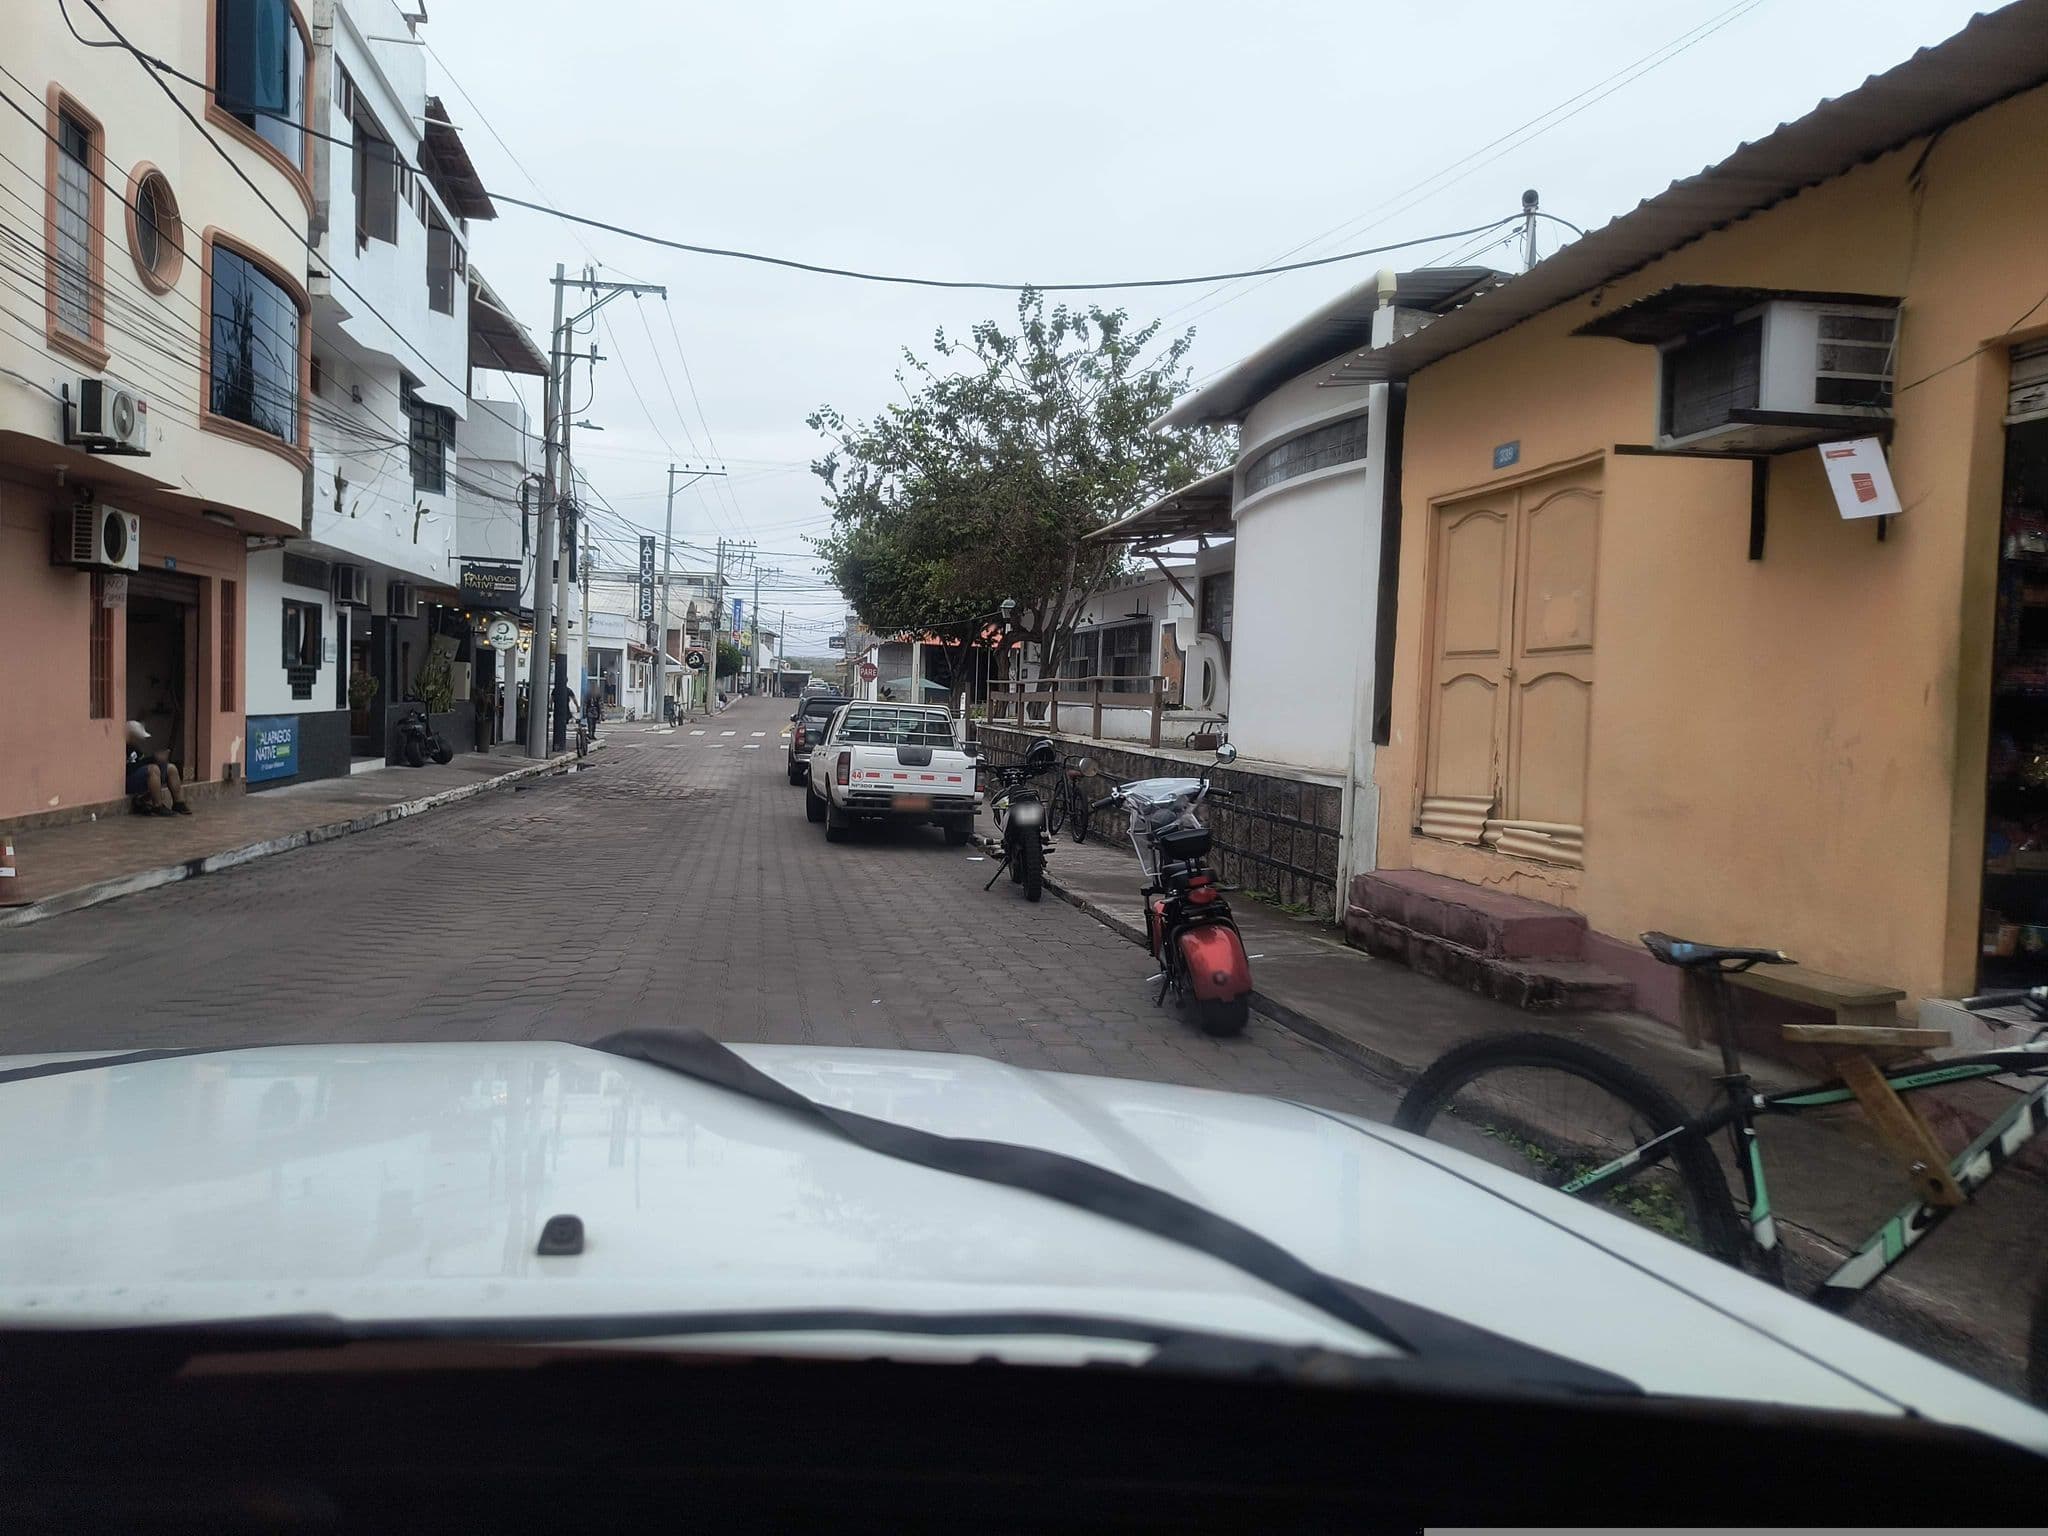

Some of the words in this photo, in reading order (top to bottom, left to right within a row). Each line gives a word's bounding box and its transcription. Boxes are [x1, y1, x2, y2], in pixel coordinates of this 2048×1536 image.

[641, 537, 653, 585] TATTOO
[641, 587, 652, 619] SHOP
[860, 668, 877, 676] PARE
[255, 745, 277, 761] NATIVE
